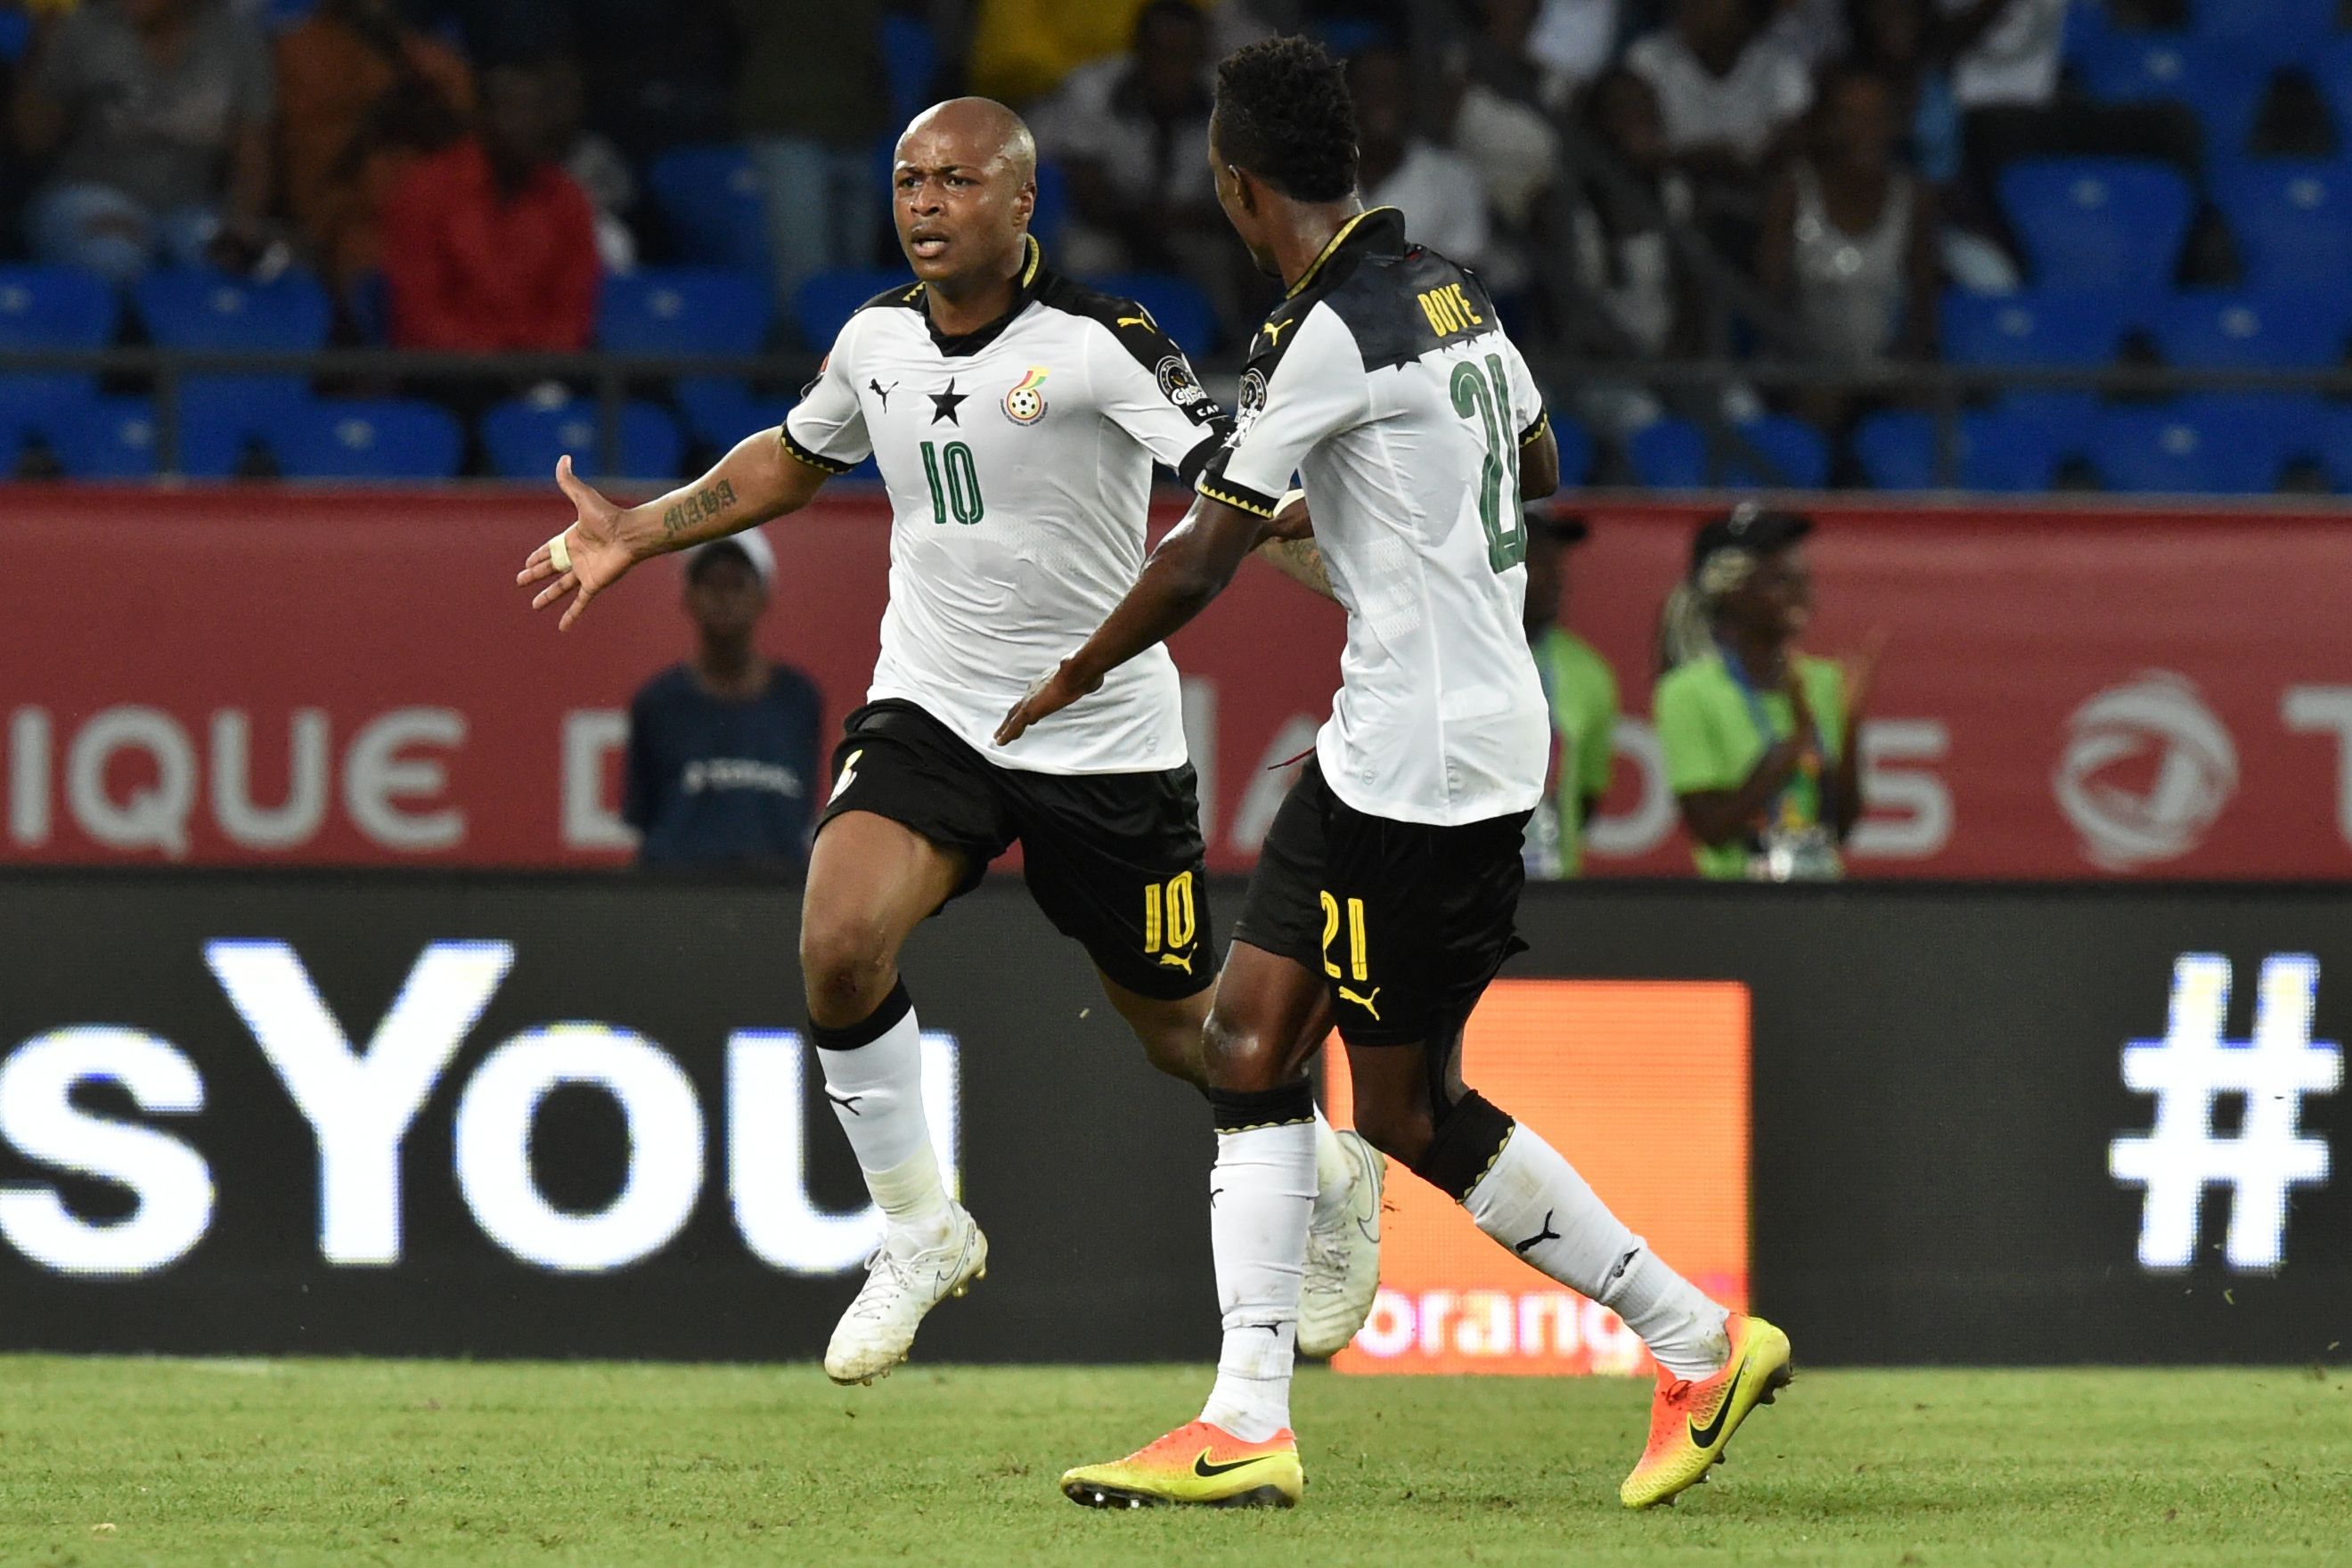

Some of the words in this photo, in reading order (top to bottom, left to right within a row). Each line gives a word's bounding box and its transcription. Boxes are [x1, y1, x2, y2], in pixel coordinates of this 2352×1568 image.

[1417, 282, 1482, 338] BOYE
[919, 440, 984, 526] 10
[1450, 353, 1527, 575] 21
[1144, 870, 1195, 953] 10
[1319, 889, 1368, 981] 21
[1355, 1286, 1646, 1376] orang
